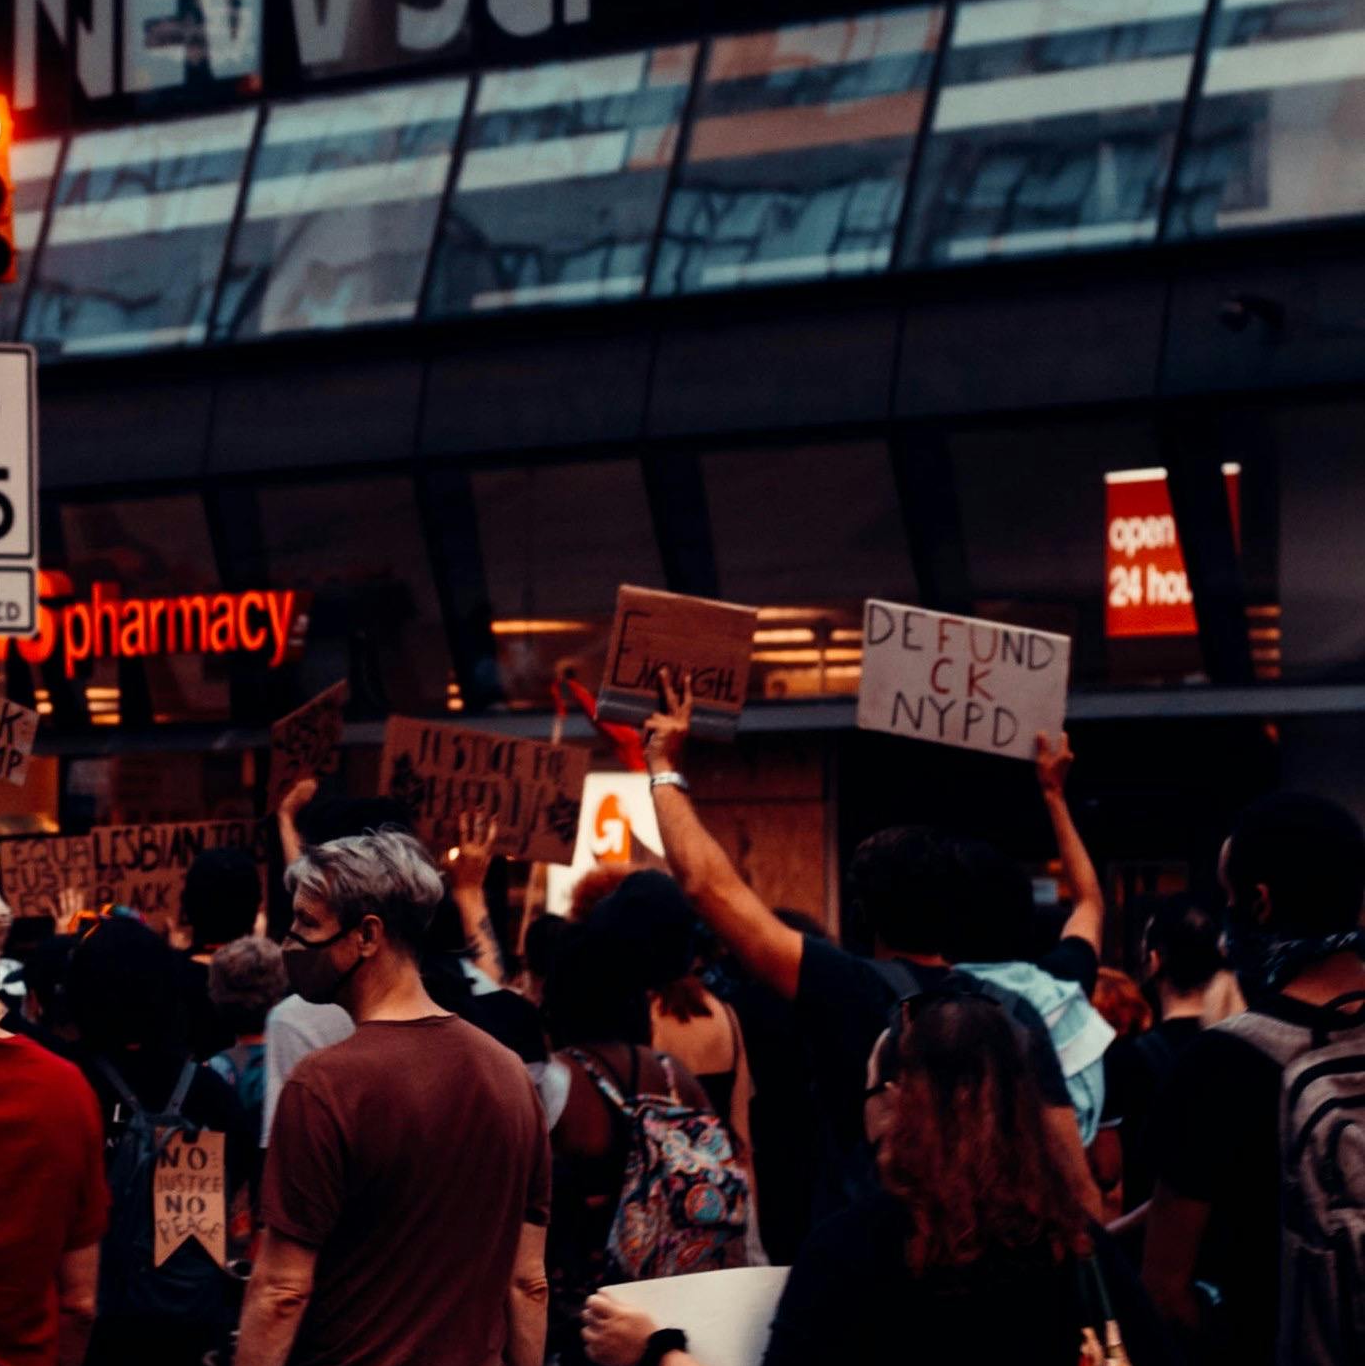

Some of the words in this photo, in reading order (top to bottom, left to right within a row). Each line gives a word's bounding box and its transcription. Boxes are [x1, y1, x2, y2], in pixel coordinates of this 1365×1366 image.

[1107, 513, 1178, 559] open
[1107, 563, 1144, 609] 24
[1145, 562, 1196, 606] hou
[62, 579, 296, 681] pharmacy
[868, 603, 1055, 671] DEFUND
[891, 690, 1020, 749] NYPD
[158, 1146, 208, 1171] NO
[164, 1194, 206, 1214] NO
